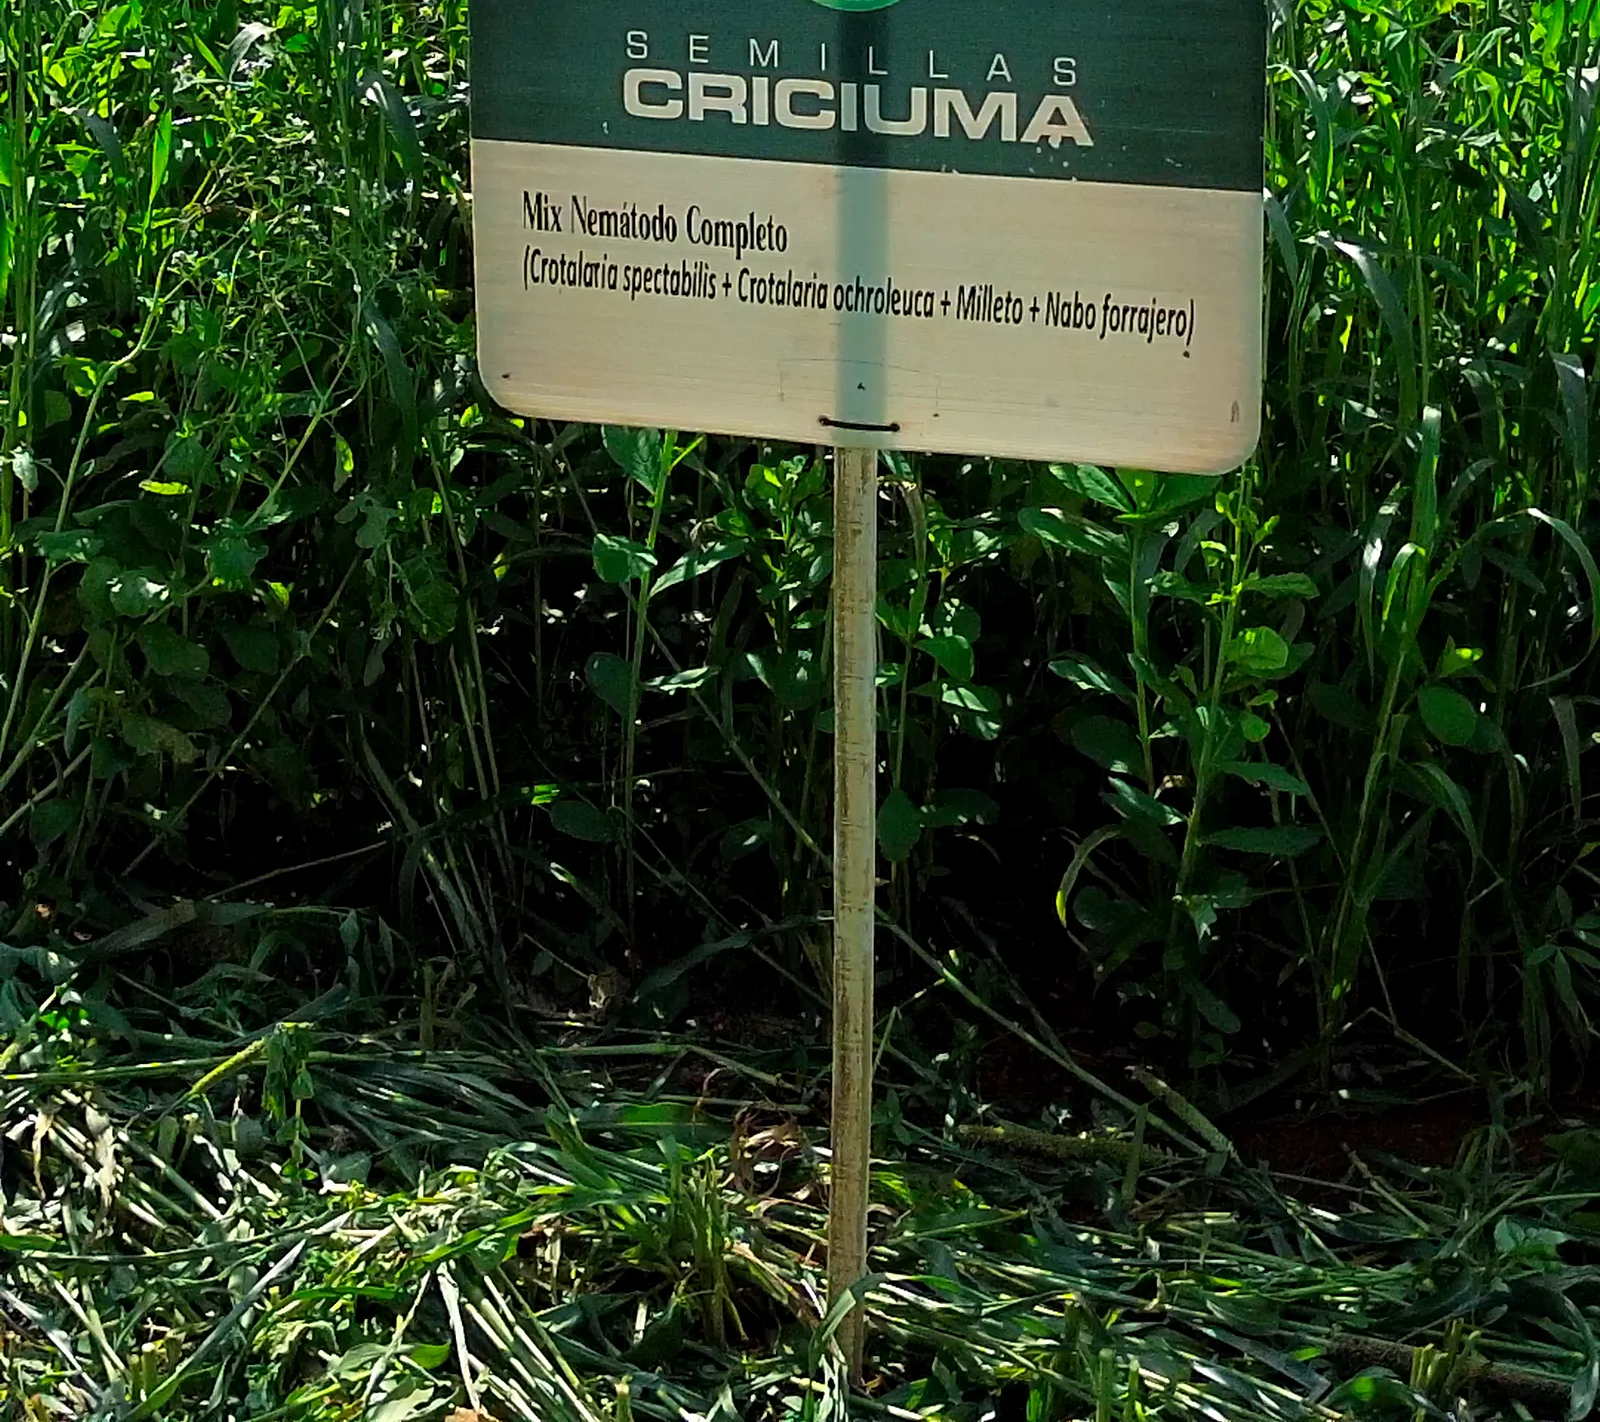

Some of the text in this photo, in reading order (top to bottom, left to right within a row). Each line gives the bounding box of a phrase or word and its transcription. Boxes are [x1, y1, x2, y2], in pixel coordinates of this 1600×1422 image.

[625, 30, 1077, 86] SEMILLAS
[623, 68, 1095, 147] CRICIUMA
[523, 190, 788, 260] Mix Nemátodo Completo
[523, 244, 1195, 346] (Crotalaria spectabilis + Crotalaria ochroleuca + Milleto + Nabo forrajero)
